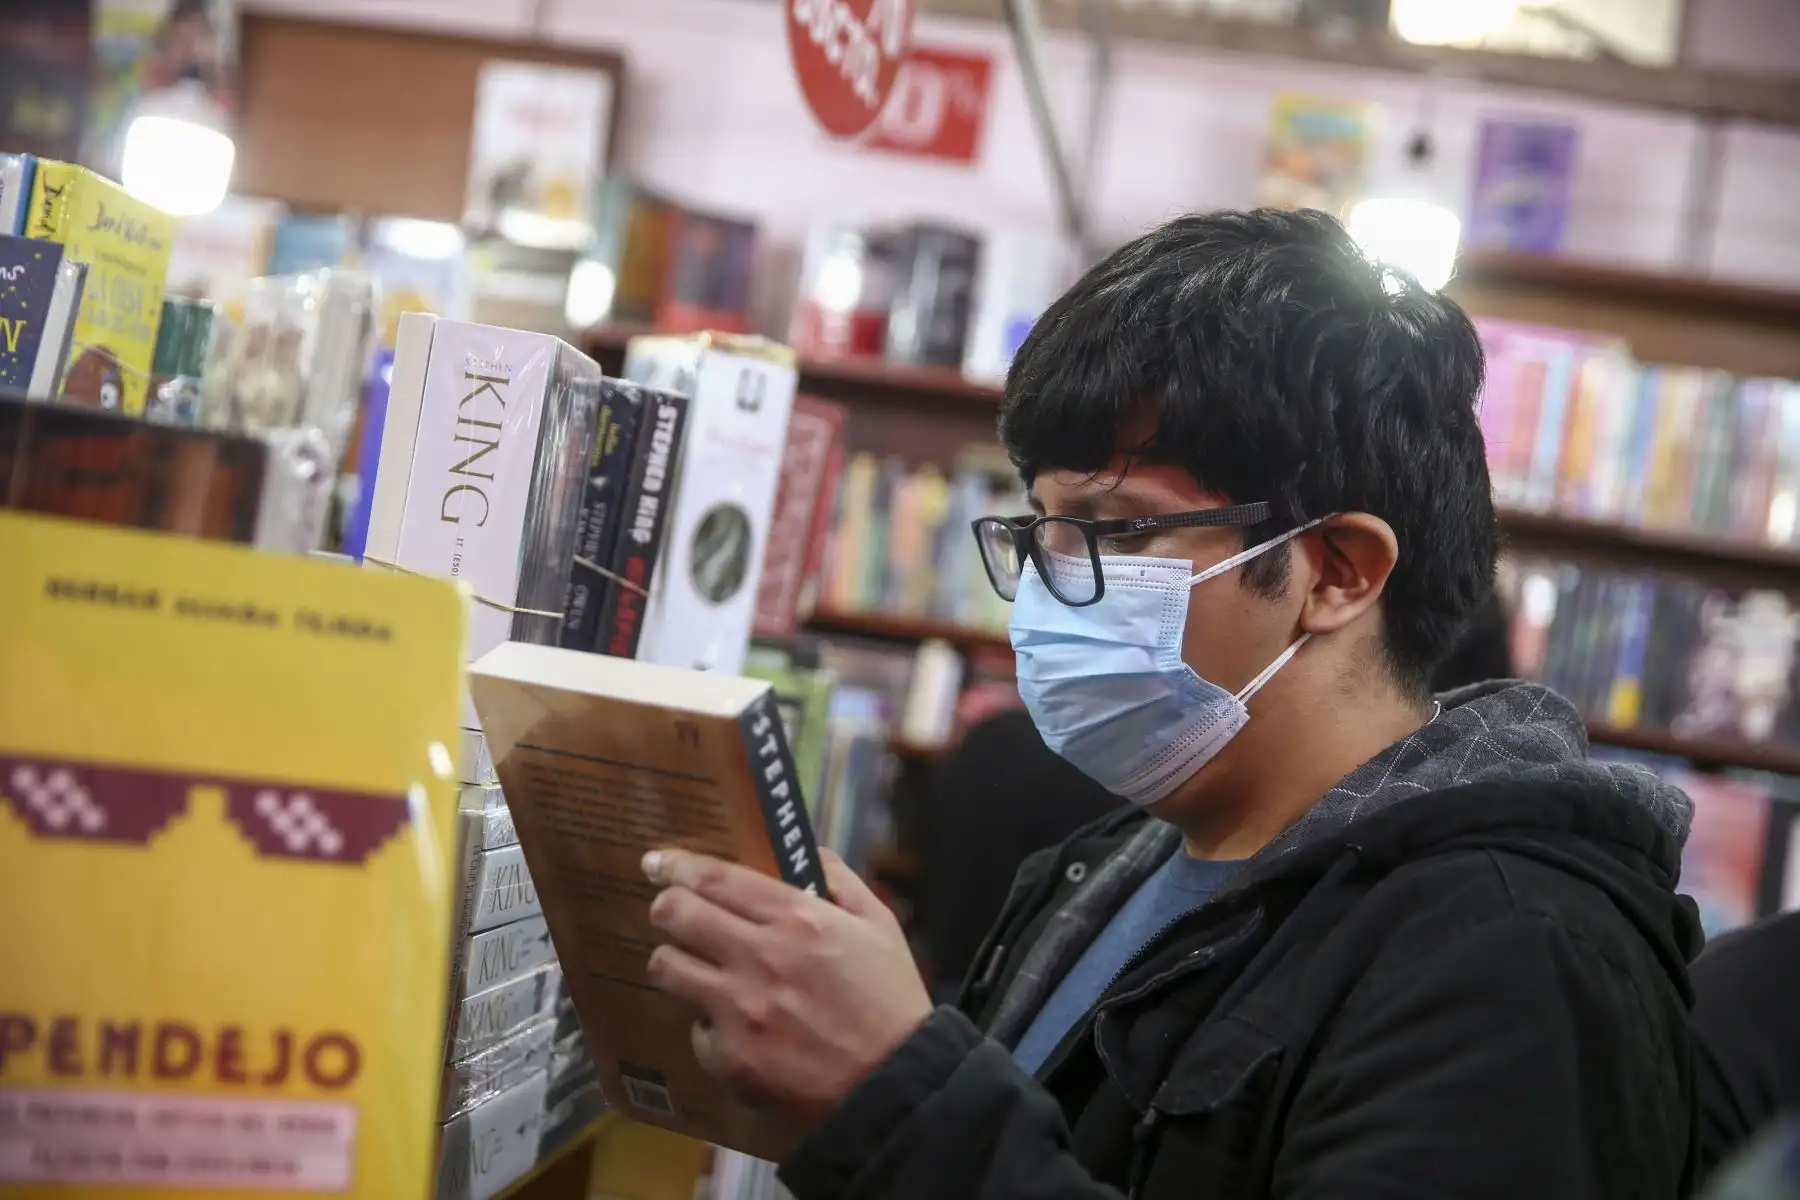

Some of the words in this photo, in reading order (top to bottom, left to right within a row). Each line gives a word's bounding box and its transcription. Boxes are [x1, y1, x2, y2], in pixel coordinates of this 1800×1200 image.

[441, 371, 509, 526] KING
[642, 404, 678, 492] STEPHEN
[629, 494, 659, 545] KING
[450, 553, 461, 577] (ESO)
[752, 715, 809, 875] STEPHEN
[0, 1013, 364, 1090] PENDEJO
